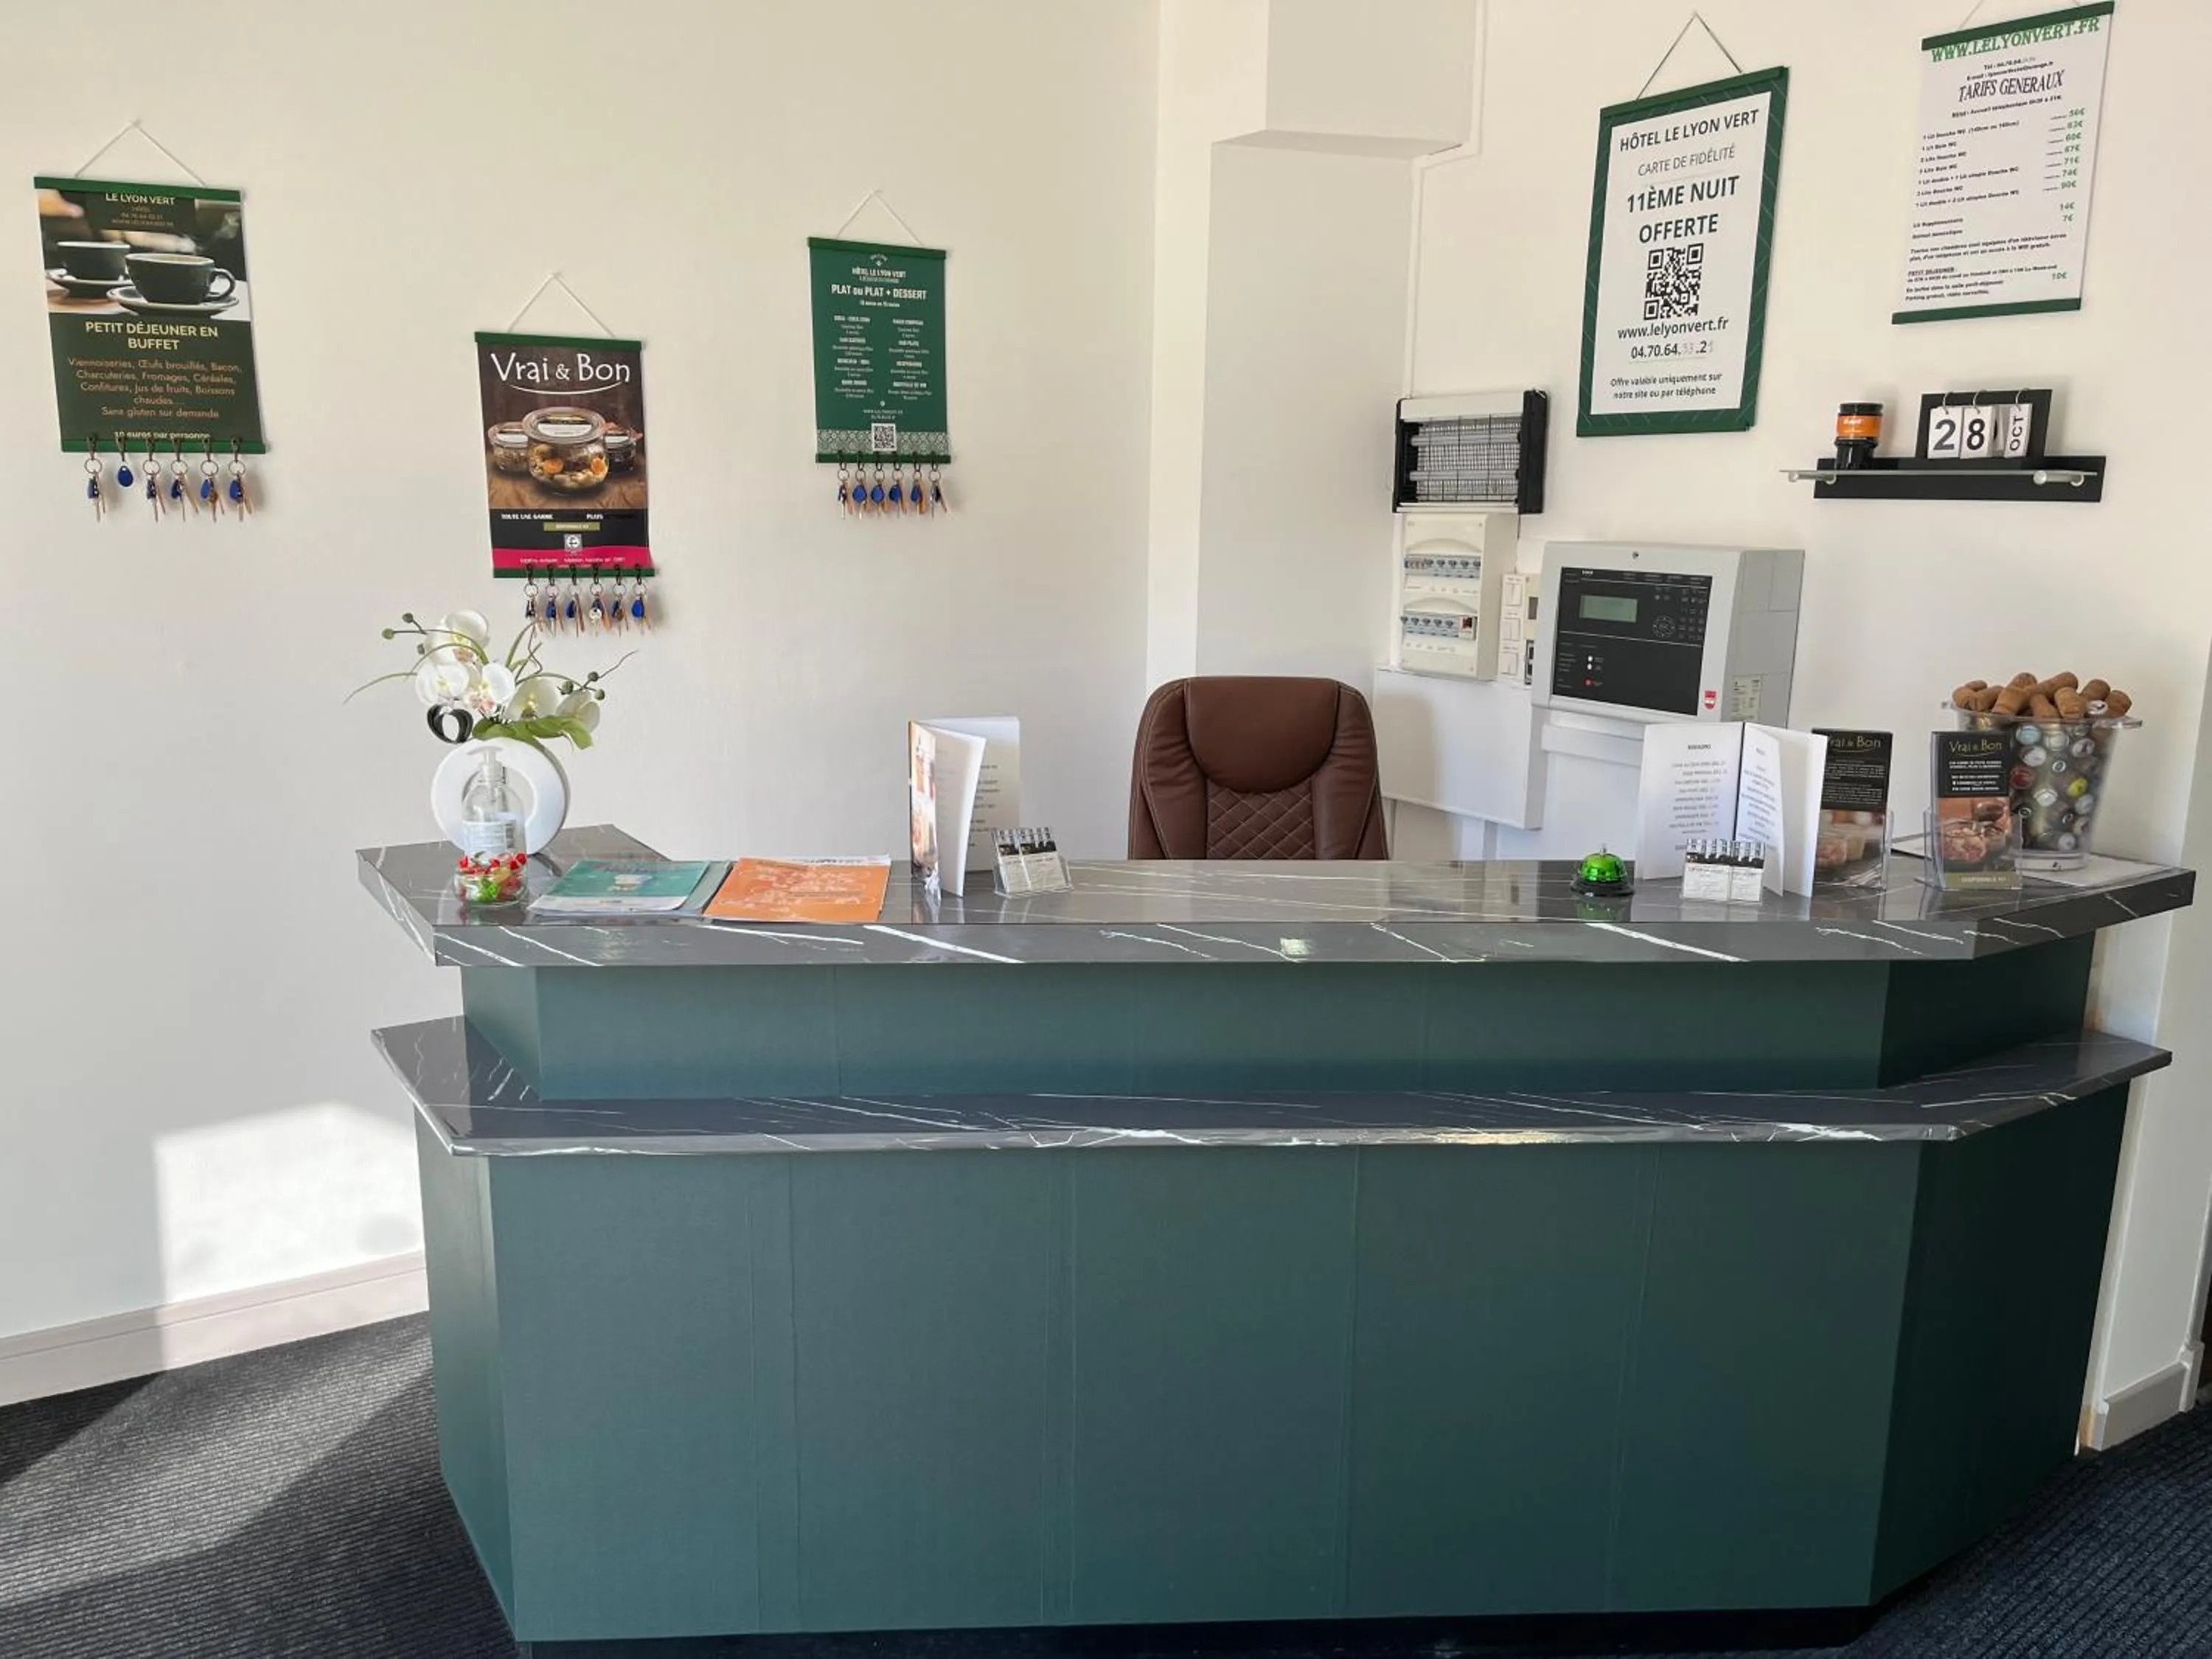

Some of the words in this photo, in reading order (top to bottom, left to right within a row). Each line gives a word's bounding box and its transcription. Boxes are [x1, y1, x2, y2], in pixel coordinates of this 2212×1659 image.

[1930, 17, 2100, 63] WWW.LELYONVERT.FR
[1958, 79, 1997, 102] TARIFS
[2000, 69, 2065, 95] GENERAUX
[1620, 132, 1660, 152] HÔTEL
[1665, 126, 1679, 142] LE
[1683, 118, 1720, 138] LYON
[1724, 109, 1759, 130] VERT
[1638, 159, 1671, 176] CARTE
[1673, 156, 1688, 170] DE
[1689, 144, 1735, 166] FIDÉLITÉ
[105, 192, 118, 201] LE
[120, 193, 147, 204] LYON
[149, 195, 175, 205] VERT
[1627, 185, 1685, 213] 11ÈME
[1690, 175, 1740, 203] NUIT
[1639, 213, 1719, 244] OFFERTE
[831, 284, 852, 294] PLAT
[864, 285, 884, 296] PLAT
[893, 288, 927, 300] DESSERT
[86, 321, 122, 333] PETIT
[125, 321, 197, 336] DÉJEUNER
[201, 327, 218, 338] EN
[1618, 316, 1729, 339] www.lelyonvert.fr
[128, 338, 180, 350] BUFFET
[490, 352, 549, 383] Vrai
[555, 364, 570, 380] &
[577, 352, 630, 383] Bon
[1933, 418, 1986, 451] 28
[2009, 415, 2024, 451] OCT
[1857, 736, 1881, 748] Bon
[1981, 739, 2002, 751] Bon
